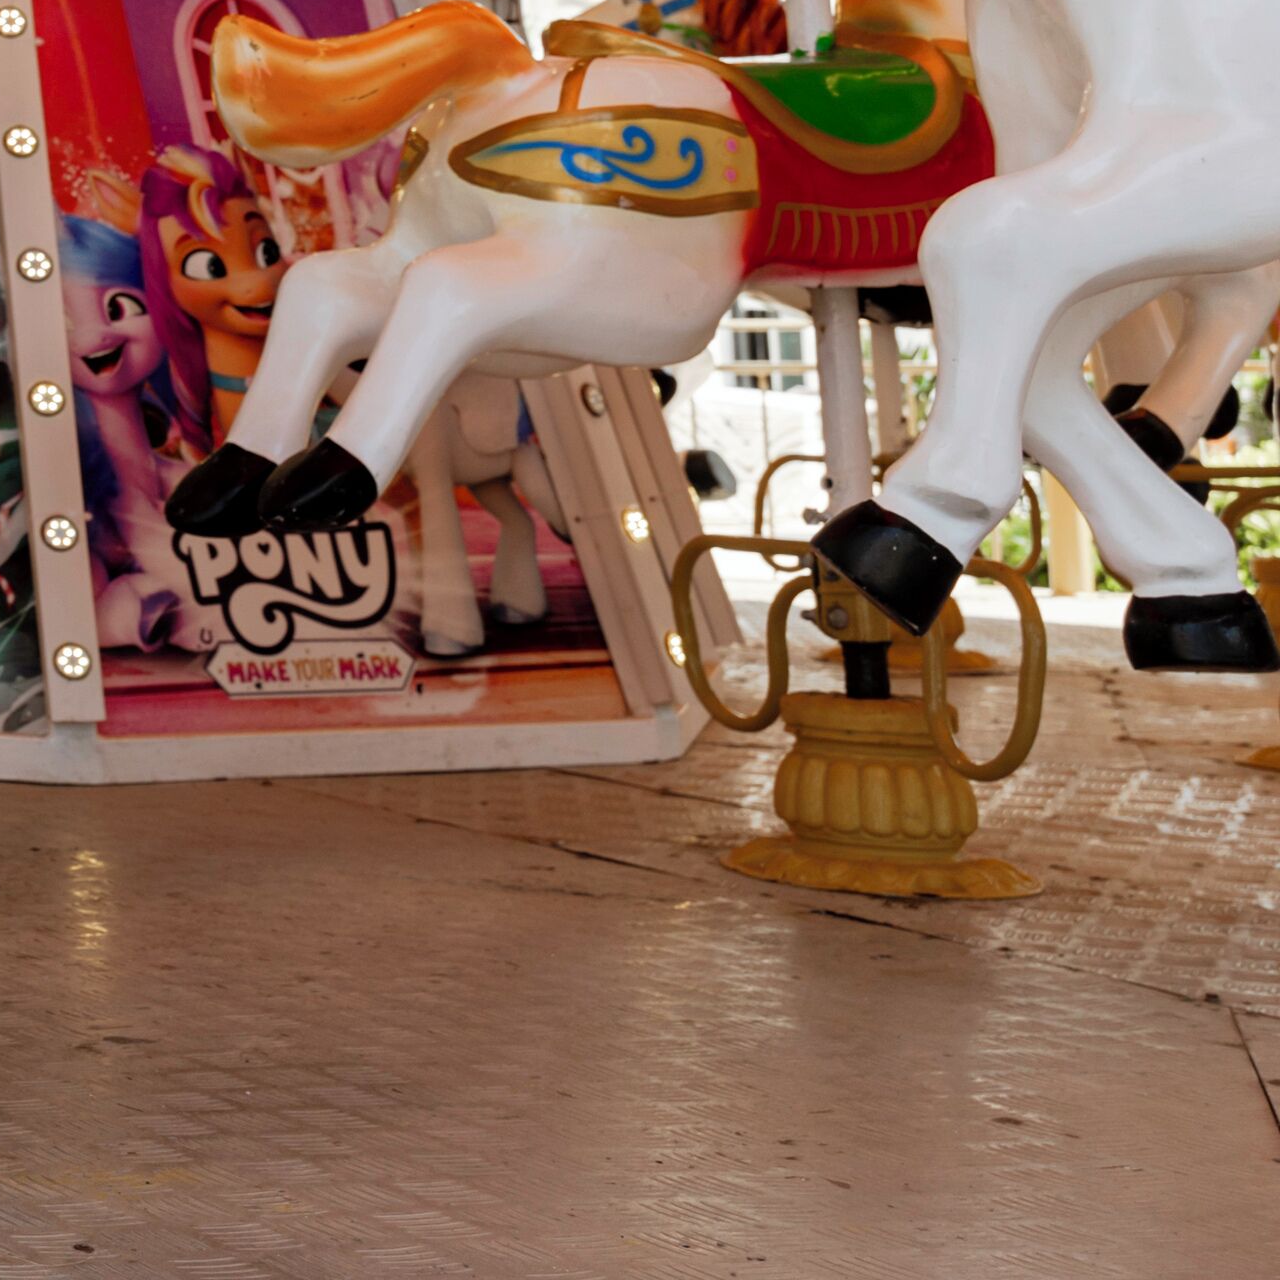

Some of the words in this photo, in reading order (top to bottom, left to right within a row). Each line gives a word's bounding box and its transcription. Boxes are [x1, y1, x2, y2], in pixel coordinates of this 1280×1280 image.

[179, 529, 391, 650] PONY
[225, 658, 292, 684] MAKE
[292, 657, 336, 682] YOUR
[337, 655, 403, 681] MARK
